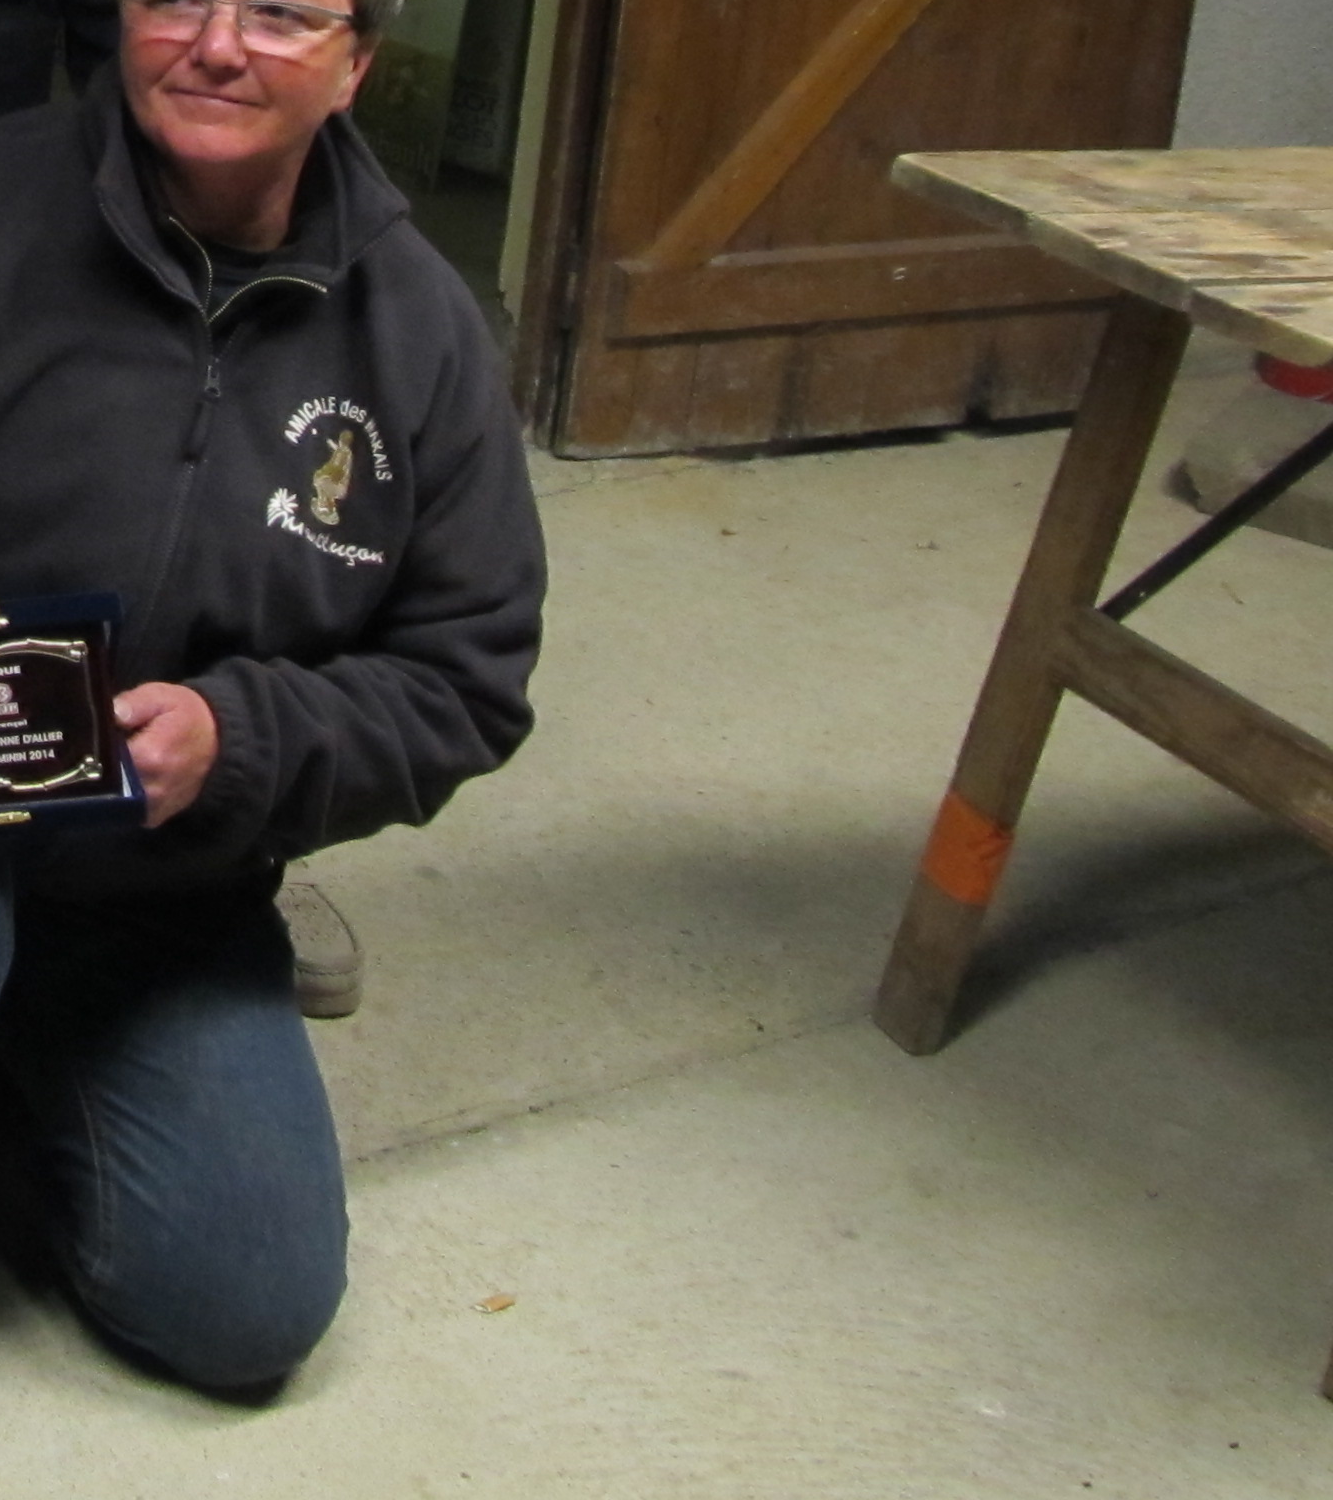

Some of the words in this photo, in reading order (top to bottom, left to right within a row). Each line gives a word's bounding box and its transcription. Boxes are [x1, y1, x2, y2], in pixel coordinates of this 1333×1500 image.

[284, 396, 336, 444] AMICALE
[339, 399, 367, 423] des
[23, 731, 63, 744] D'ALLIER
[29, 749, 55, 760] 2014
